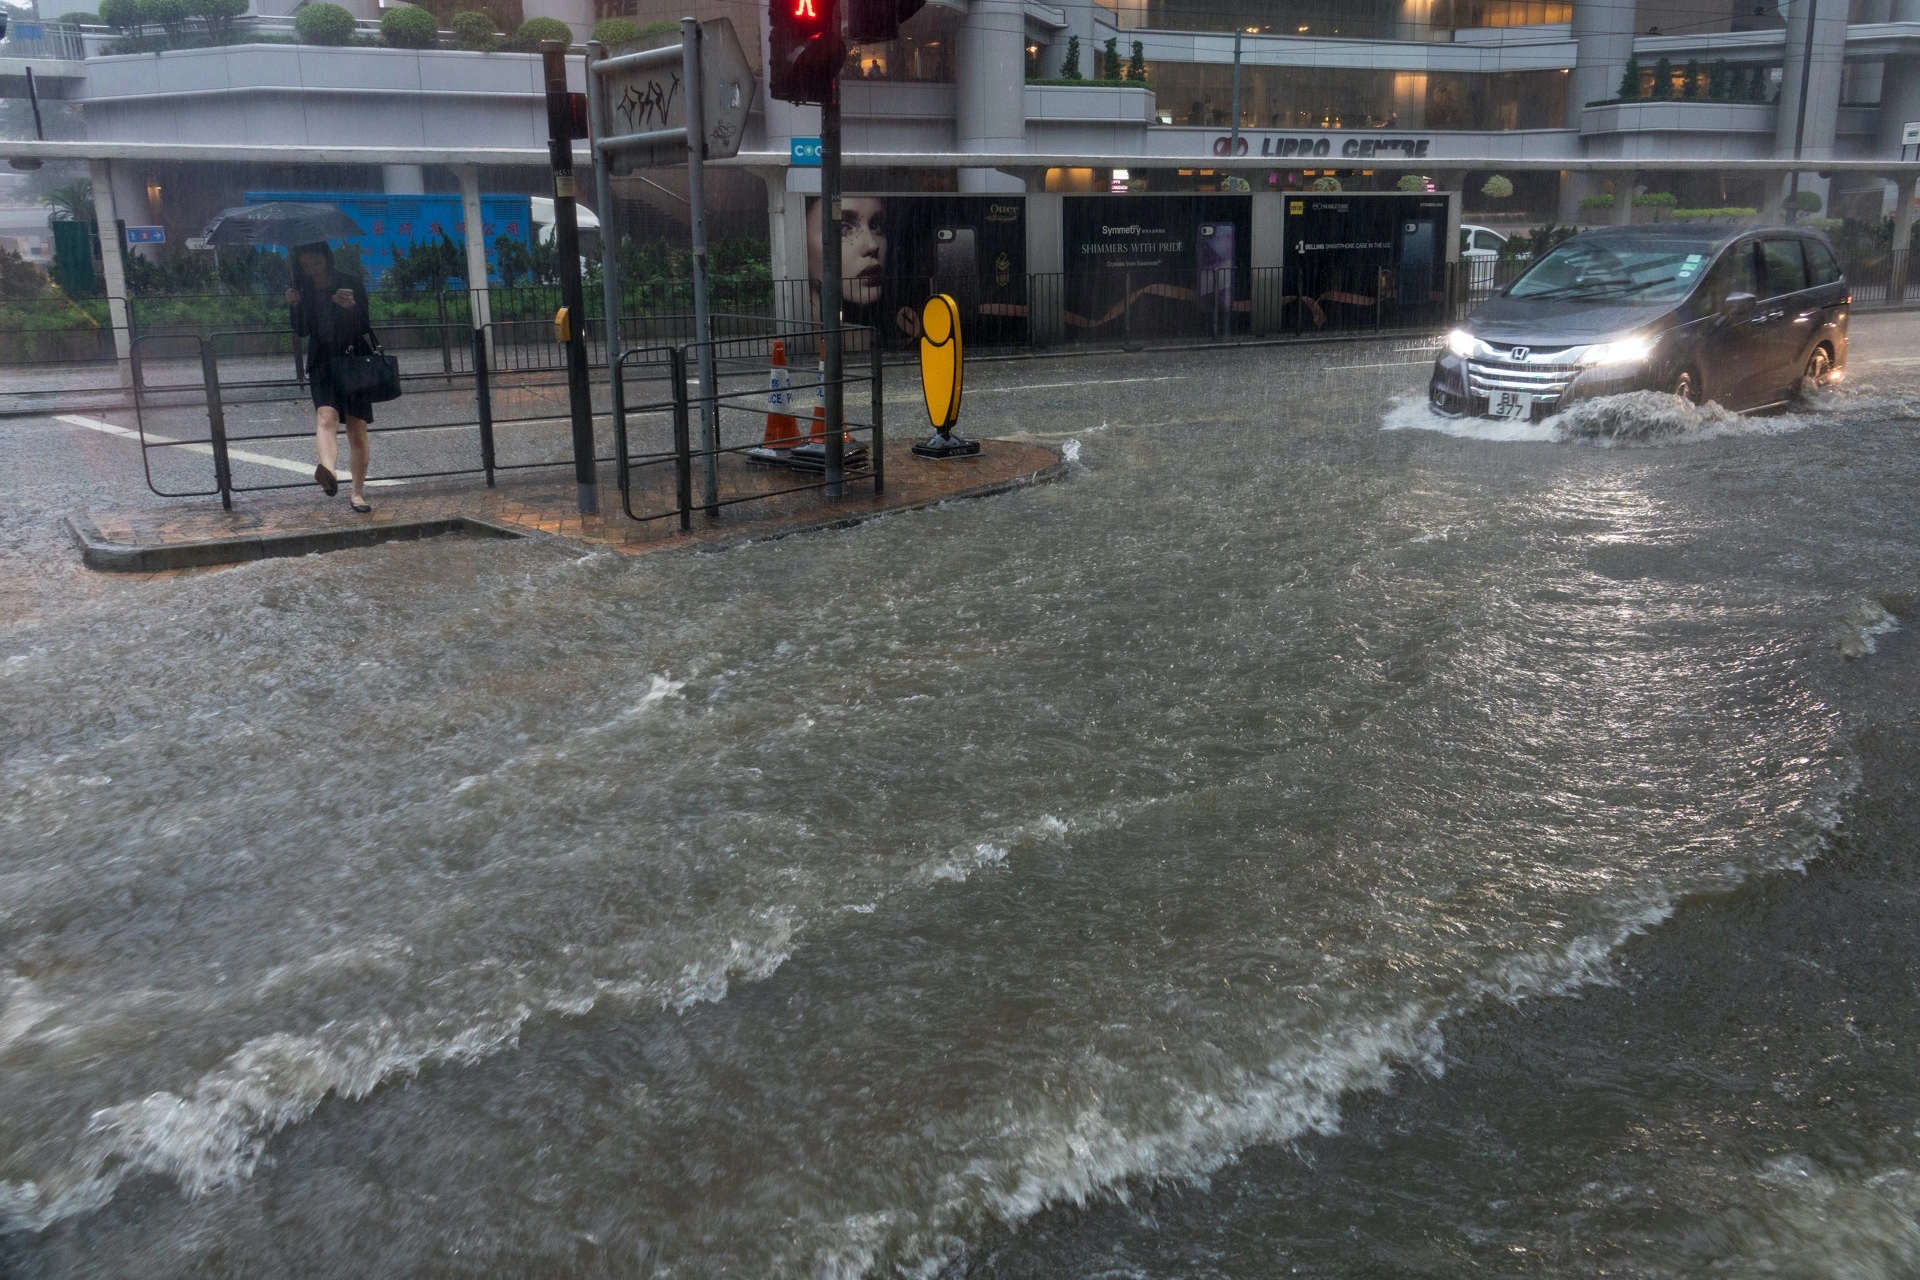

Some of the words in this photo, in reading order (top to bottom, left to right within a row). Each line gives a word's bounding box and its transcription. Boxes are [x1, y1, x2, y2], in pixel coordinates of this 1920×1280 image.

[1261, 138, 1331, 157] LIPPO
[1102, 225, 1142, 237] Symmetry
[1081, 243, 1129, 254] SHIMMERS
[1131, 242, 1156, 253] WITH
[1159, 241, 1184, 252] PRIDE
[1496, 403, 1524, 416] 377
